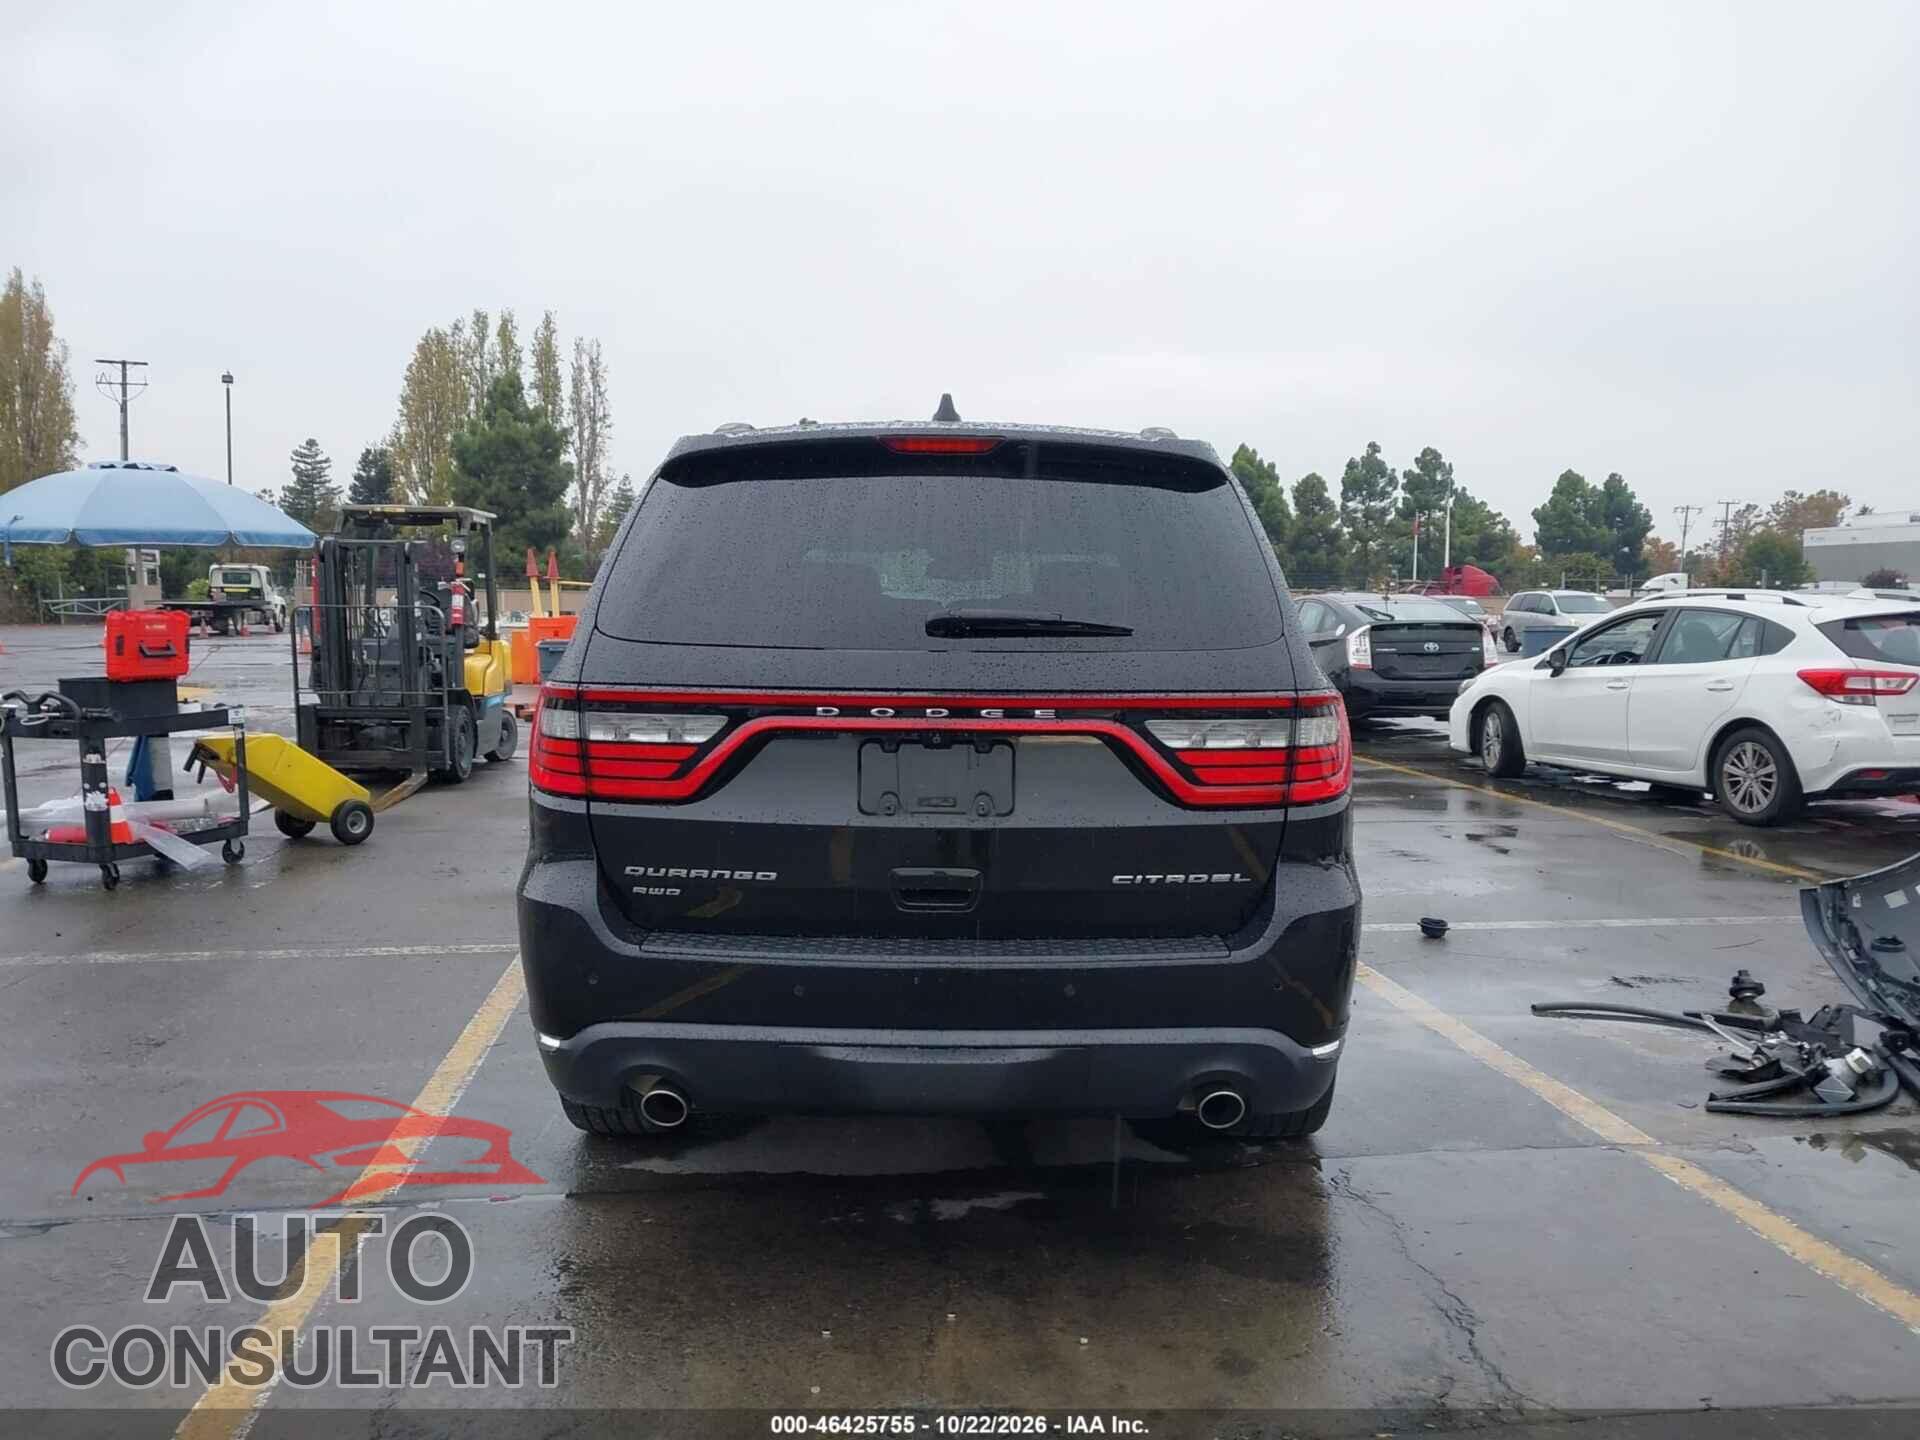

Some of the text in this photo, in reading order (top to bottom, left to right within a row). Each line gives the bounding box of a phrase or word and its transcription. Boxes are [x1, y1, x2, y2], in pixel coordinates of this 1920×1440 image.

[816, 706, 1057, 719] DODGE
[624, 866, 778, 881] DURANGO
[1112, 873, 1251, 884] CITADEL
